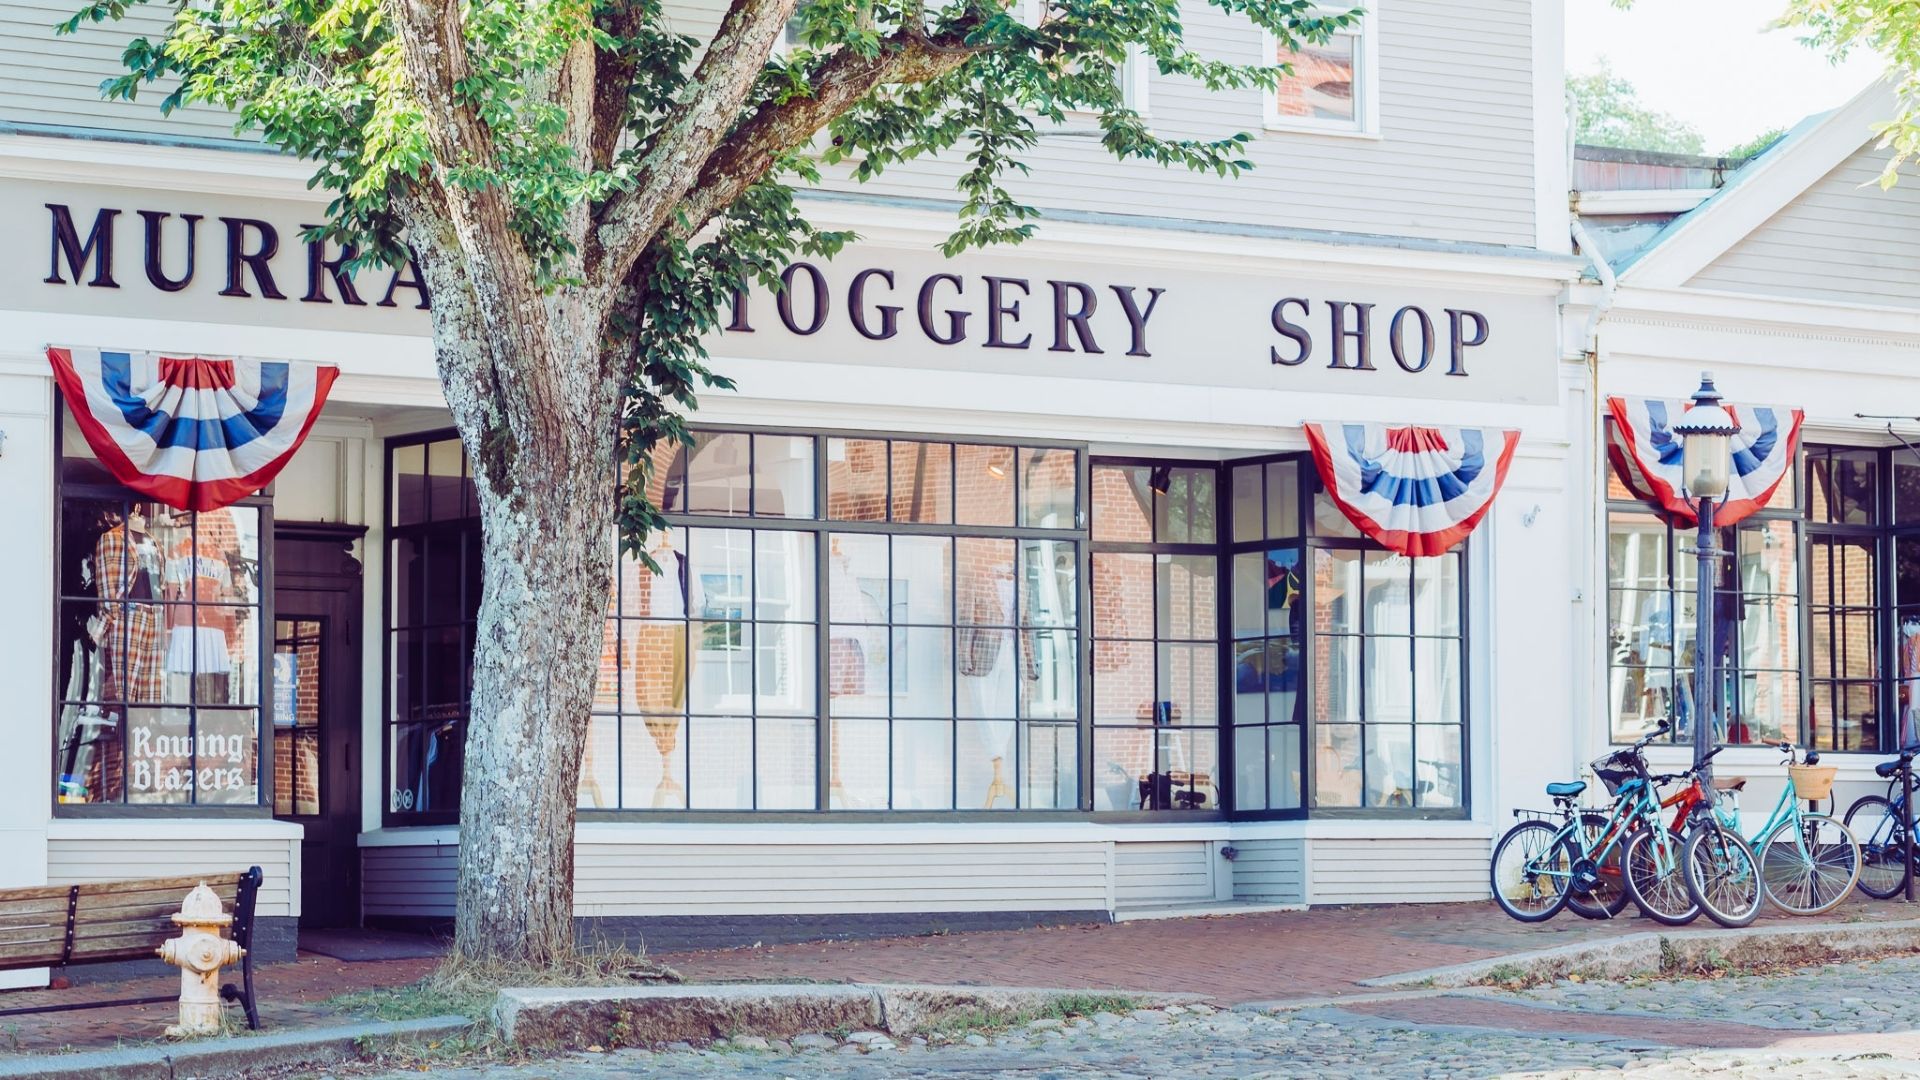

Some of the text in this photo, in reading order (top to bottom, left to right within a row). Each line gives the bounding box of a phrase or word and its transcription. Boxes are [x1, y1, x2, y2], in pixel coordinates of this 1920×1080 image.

[44, 203, 432, 310] MURRA
[1270, 297, 1490, 377] SHOP
[131, 726, 245, 763] Rowing
[132, 759, 245, 791] Blazers
